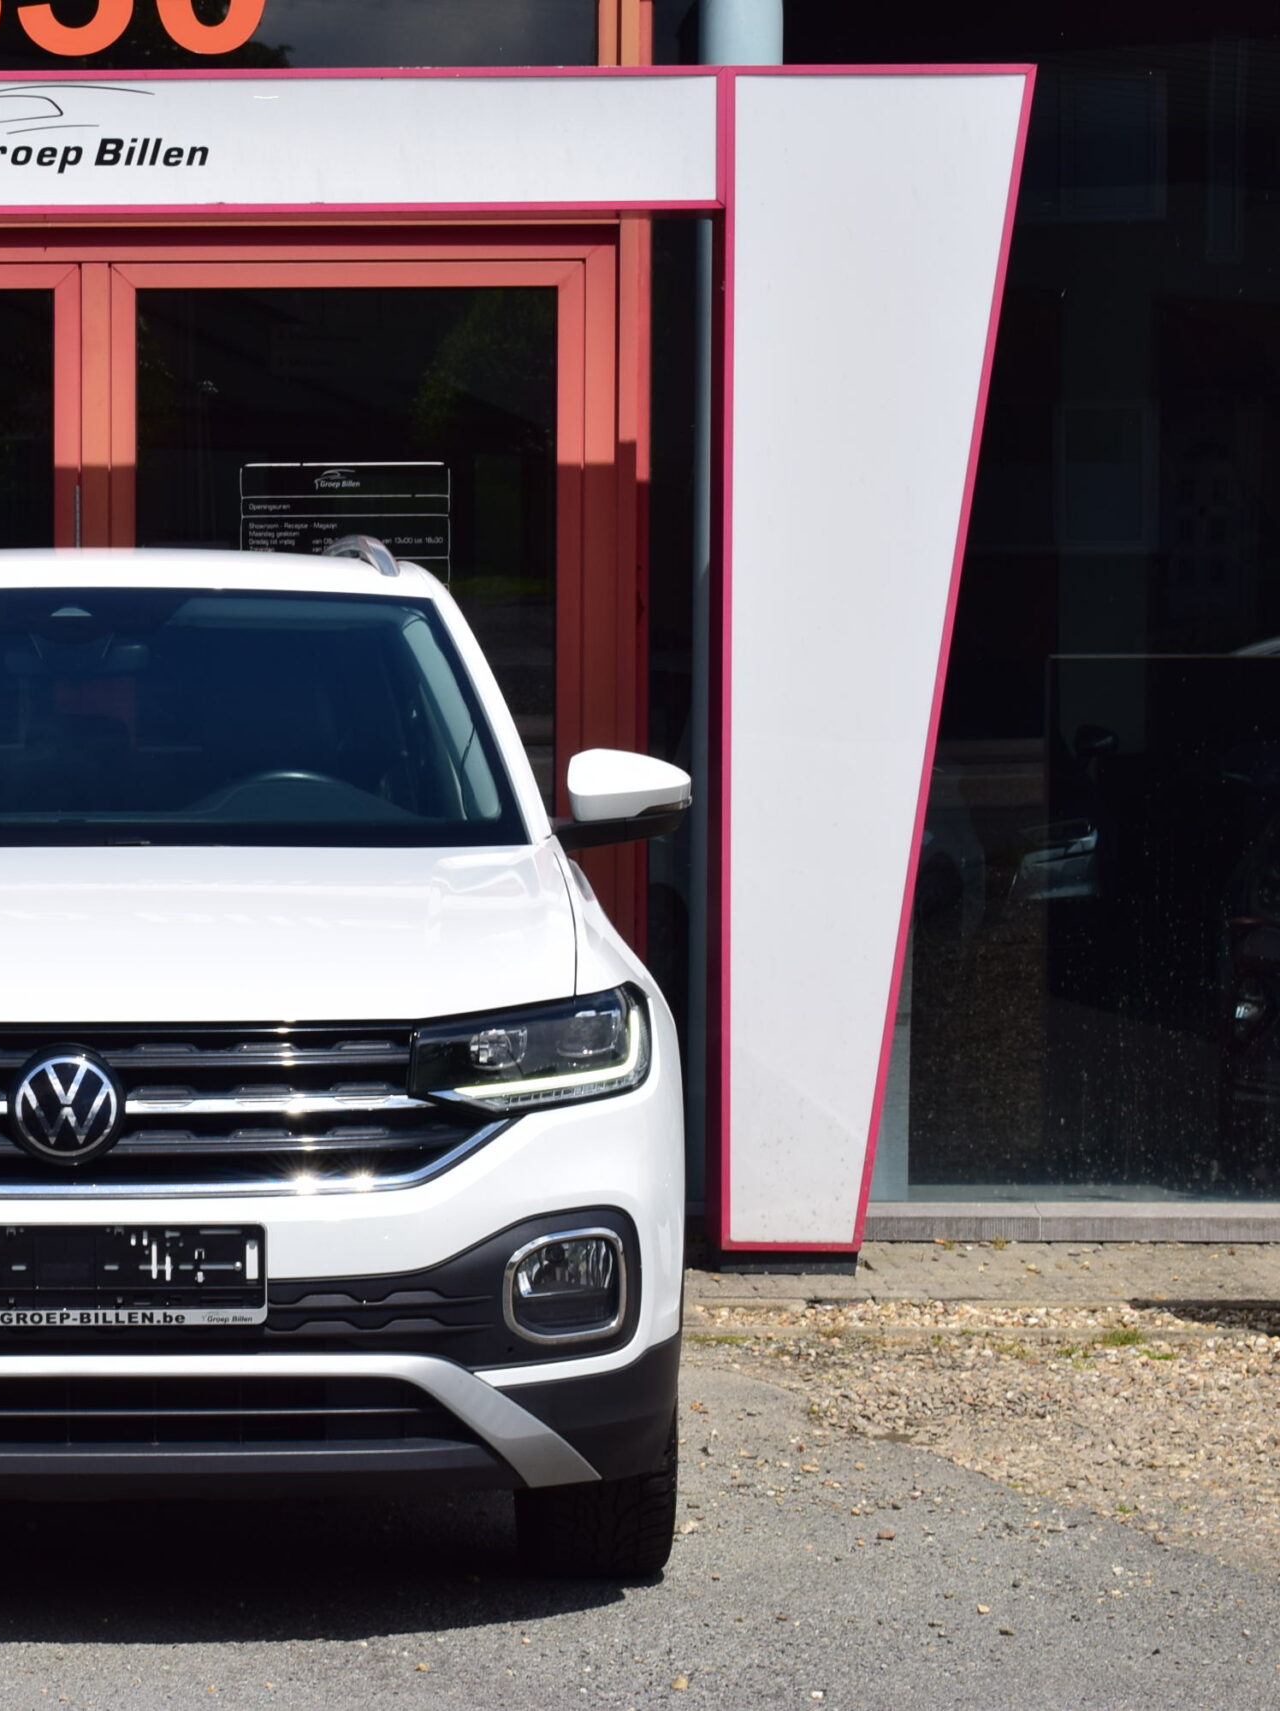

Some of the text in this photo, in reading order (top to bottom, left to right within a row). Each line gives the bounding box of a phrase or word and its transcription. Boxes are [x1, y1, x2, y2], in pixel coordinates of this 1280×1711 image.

[94, 137, 210, 167] Billen
[320, 480, 361, 489] Groep Billen
[207, 1315, 253, 1325] Groep Billen
